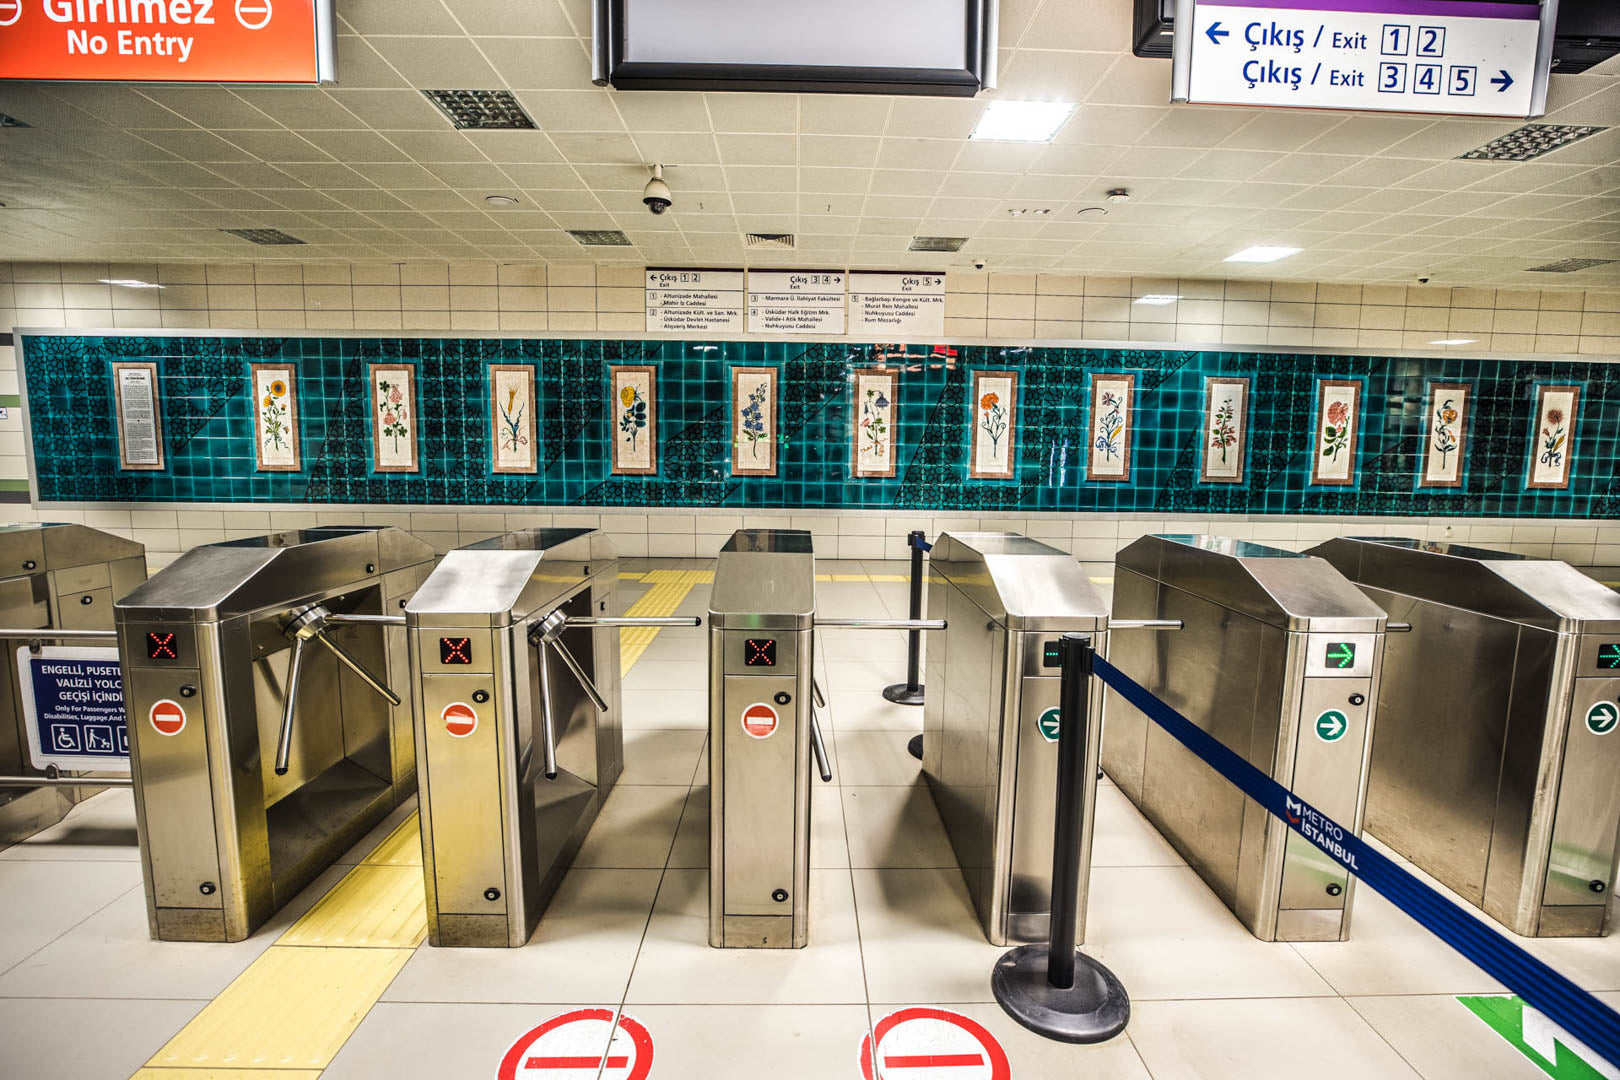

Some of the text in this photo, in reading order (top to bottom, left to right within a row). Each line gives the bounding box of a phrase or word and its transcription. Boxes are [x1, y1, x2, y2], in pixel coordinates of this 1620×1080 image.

[67, 30, 194, 62] No Entry
[1244, 22, 1304, 53] Çıkış
[1333, 32, 1367, 50] Exit
[1389, 28, 1400, 51] 1
[1422, 29, 1438, 53] 2
[1242, 60, 1302, 90] Çıkış
[1330, 70, 1364, 87] Exit
[1383, 66, 1398, 89] 3
[1419, 67, 1435, 90] 4
[1455, 69, 1469, 91] 5
[660, 274, 677, 282] Çıkış
[902, 278, 919, 286] Çıkış
[42, 665, 84, 676] ENGELLİ,
[56, 677, 92, 688] VALİZLİ
[59, 690, 90, 702] GEÇİŞİ
[1303, 806, 1343, 840] METRO
[1302, 819, 1358, 870] İSTANBUL
